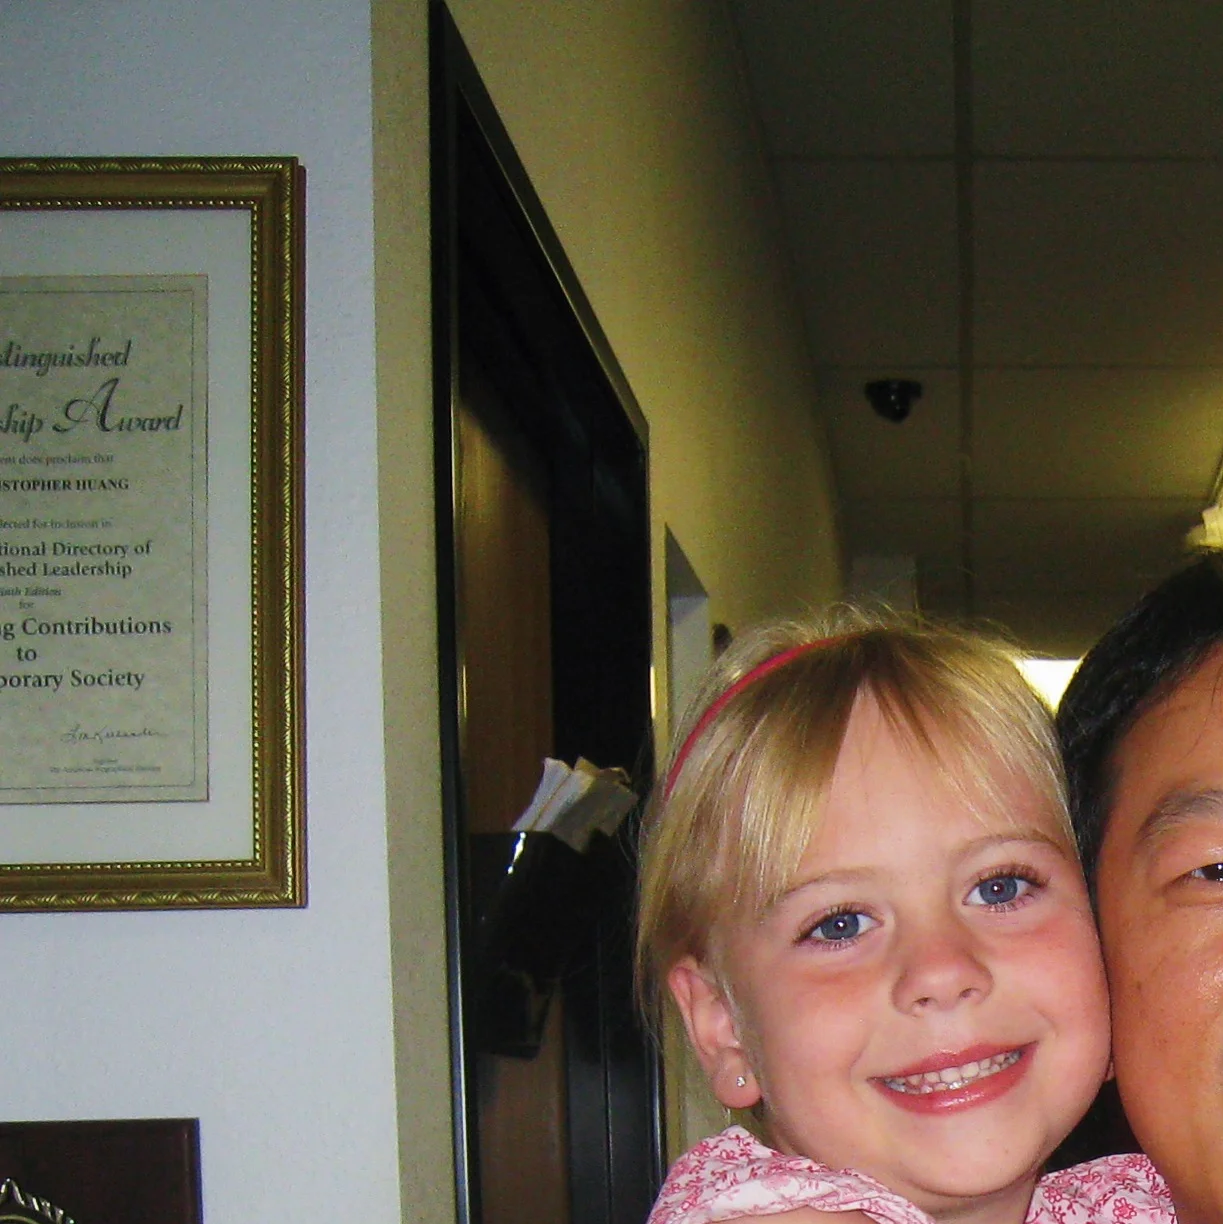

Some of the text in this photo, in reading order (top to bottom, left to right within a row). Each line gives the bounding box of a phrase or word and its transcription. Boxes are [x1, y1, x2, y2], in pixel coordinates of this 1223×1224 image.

[52, 377, 183, 433] Award
[76, 478, 130, 491] HUANG
[52, 541, 128, 559] Directory
[134, 539, 153, 555] of
[43, 560, 133, 579] Leadership
[22, 616, 173, 636] Contributions
[16, 647, 37, 662] to
[70, 669, 144, 690] Society
